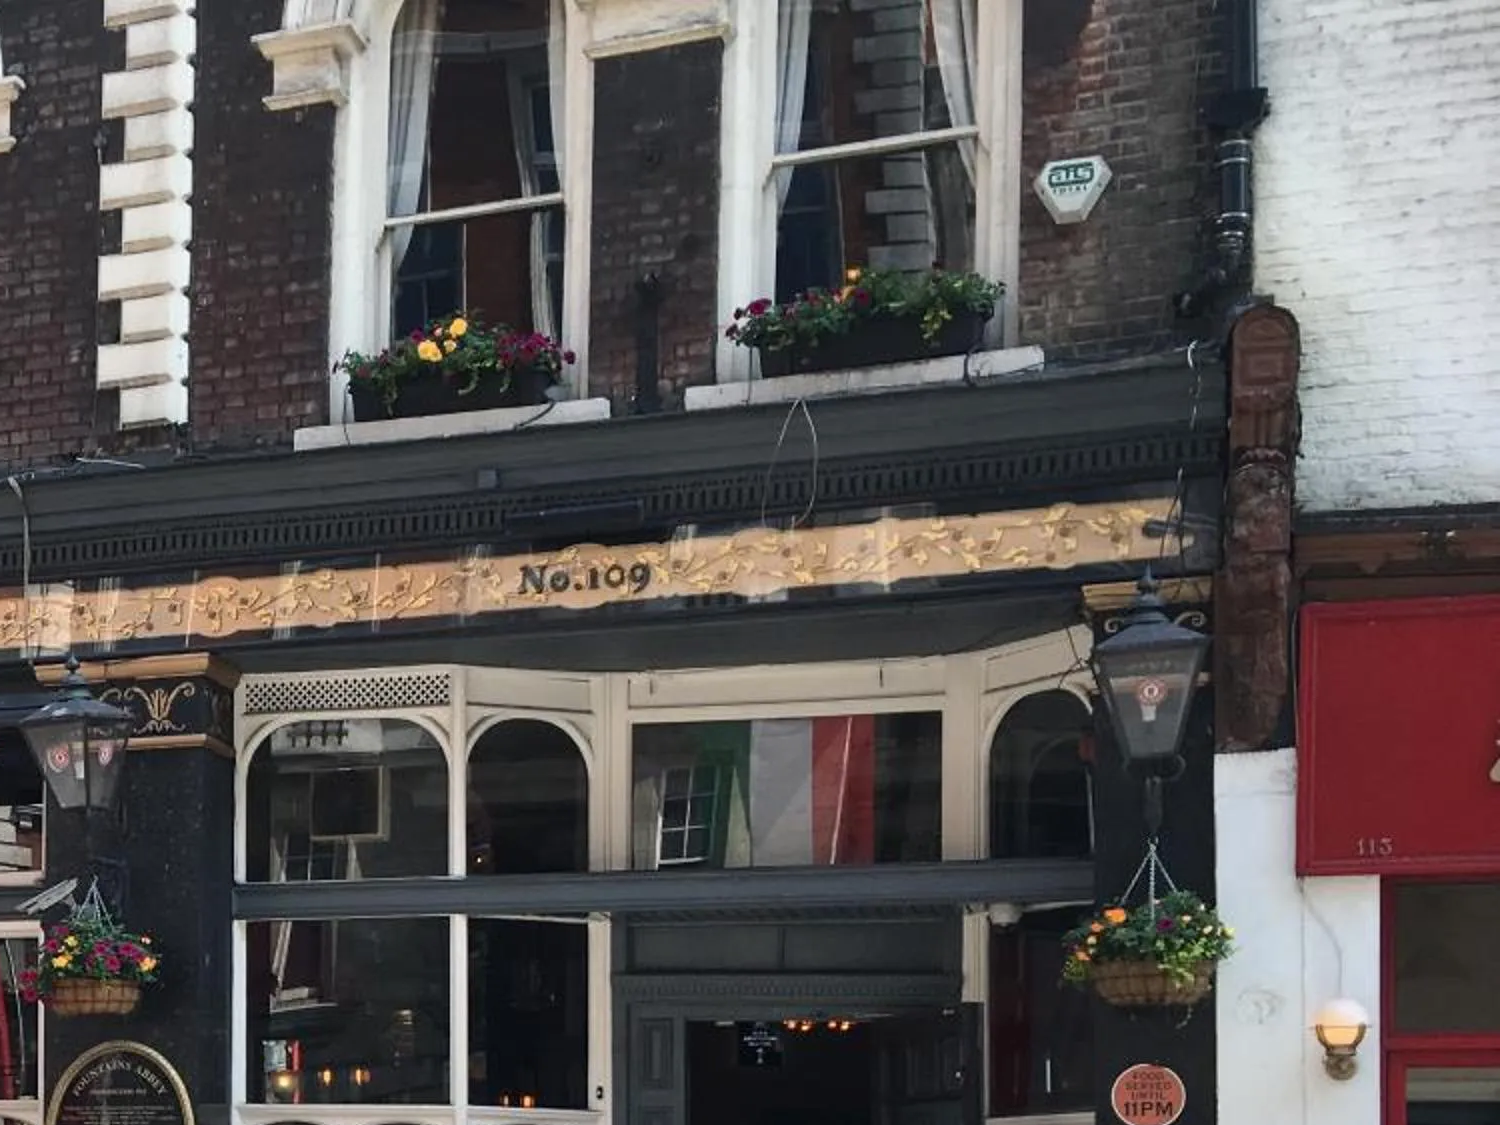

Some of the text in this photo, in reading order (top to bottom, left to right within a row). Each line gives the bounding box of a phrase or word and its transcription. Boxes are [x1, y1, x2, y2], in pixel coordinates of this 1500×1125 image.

[72, 1058, 168, 1097] FOUNTAINS ABBEY
[1132, 1071, 1165, 1080] FOOD
[1124, 1081, 1173, 1090] SERVED
[1131, 1091, 1165, 1101] UNTIL
[1123, 1101, 1174, 1117] 11PM
